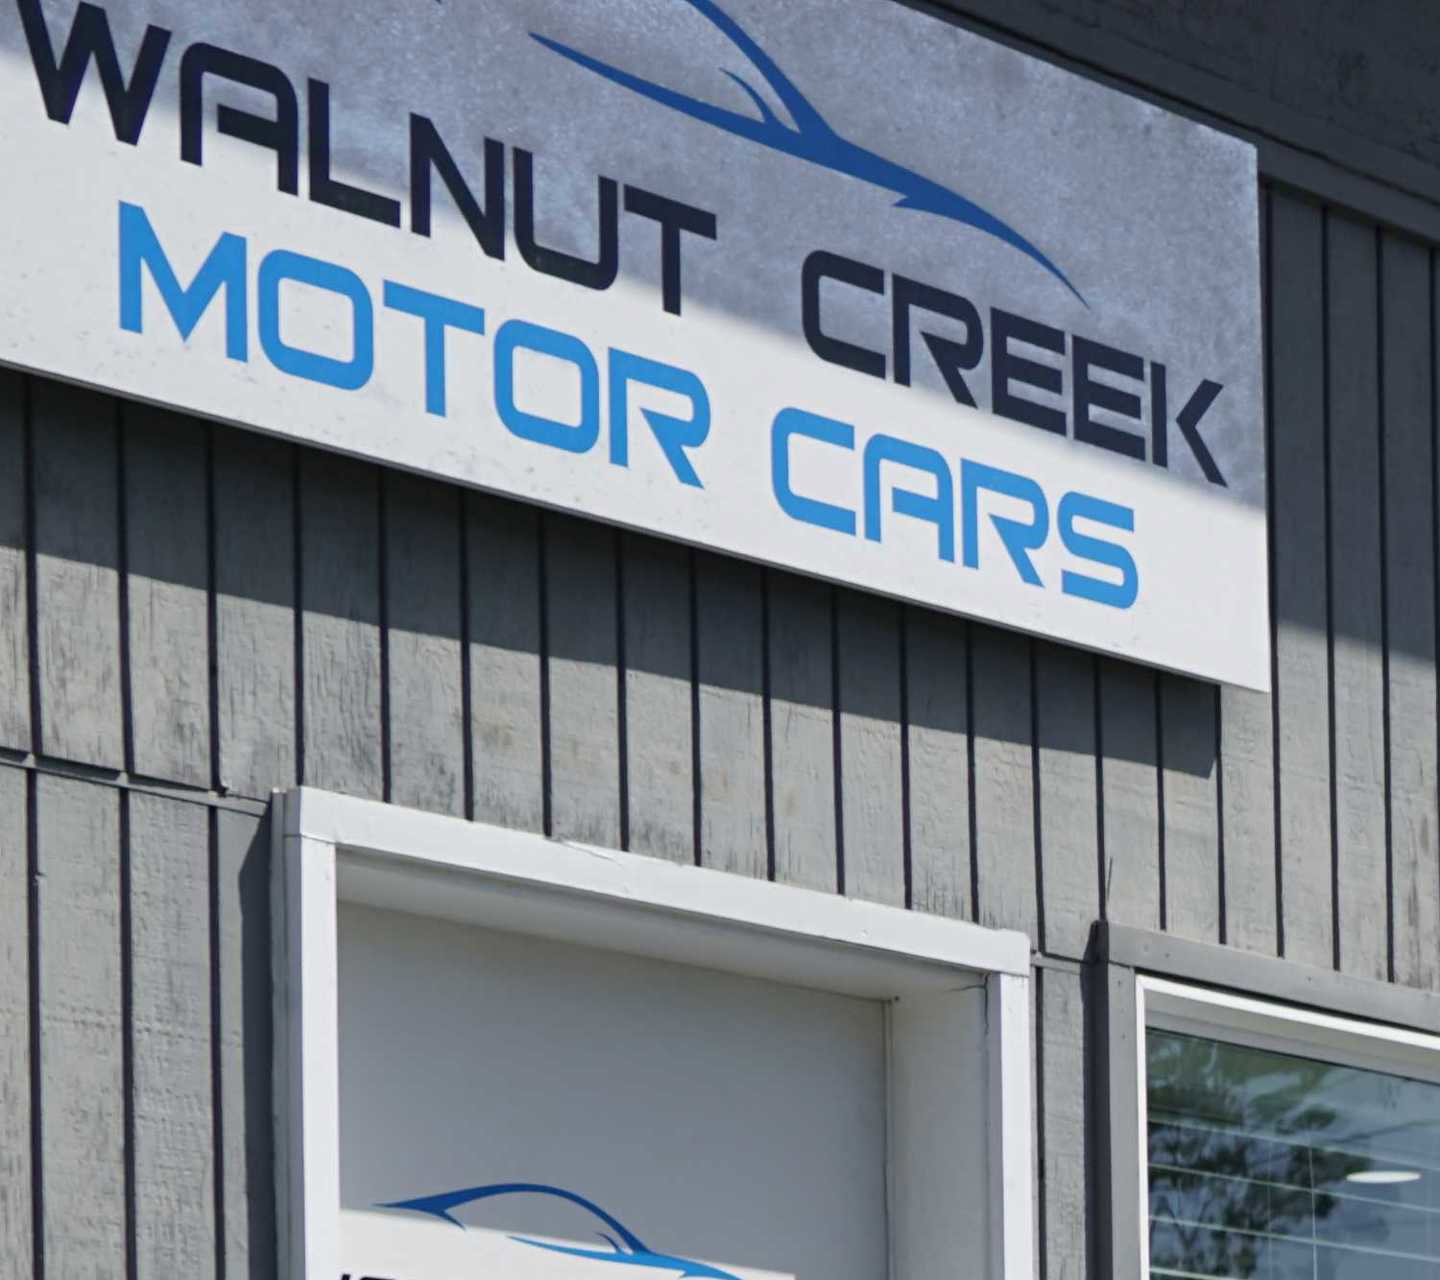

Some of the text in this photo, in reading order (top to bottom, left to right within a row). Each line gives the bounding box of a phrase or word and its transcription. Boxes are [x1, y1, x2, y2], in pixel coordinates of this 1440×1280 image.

[15, 0, 1228, 489] WALNUT CREEK
[118, 200, 1140, 609] MOTOR CARS
